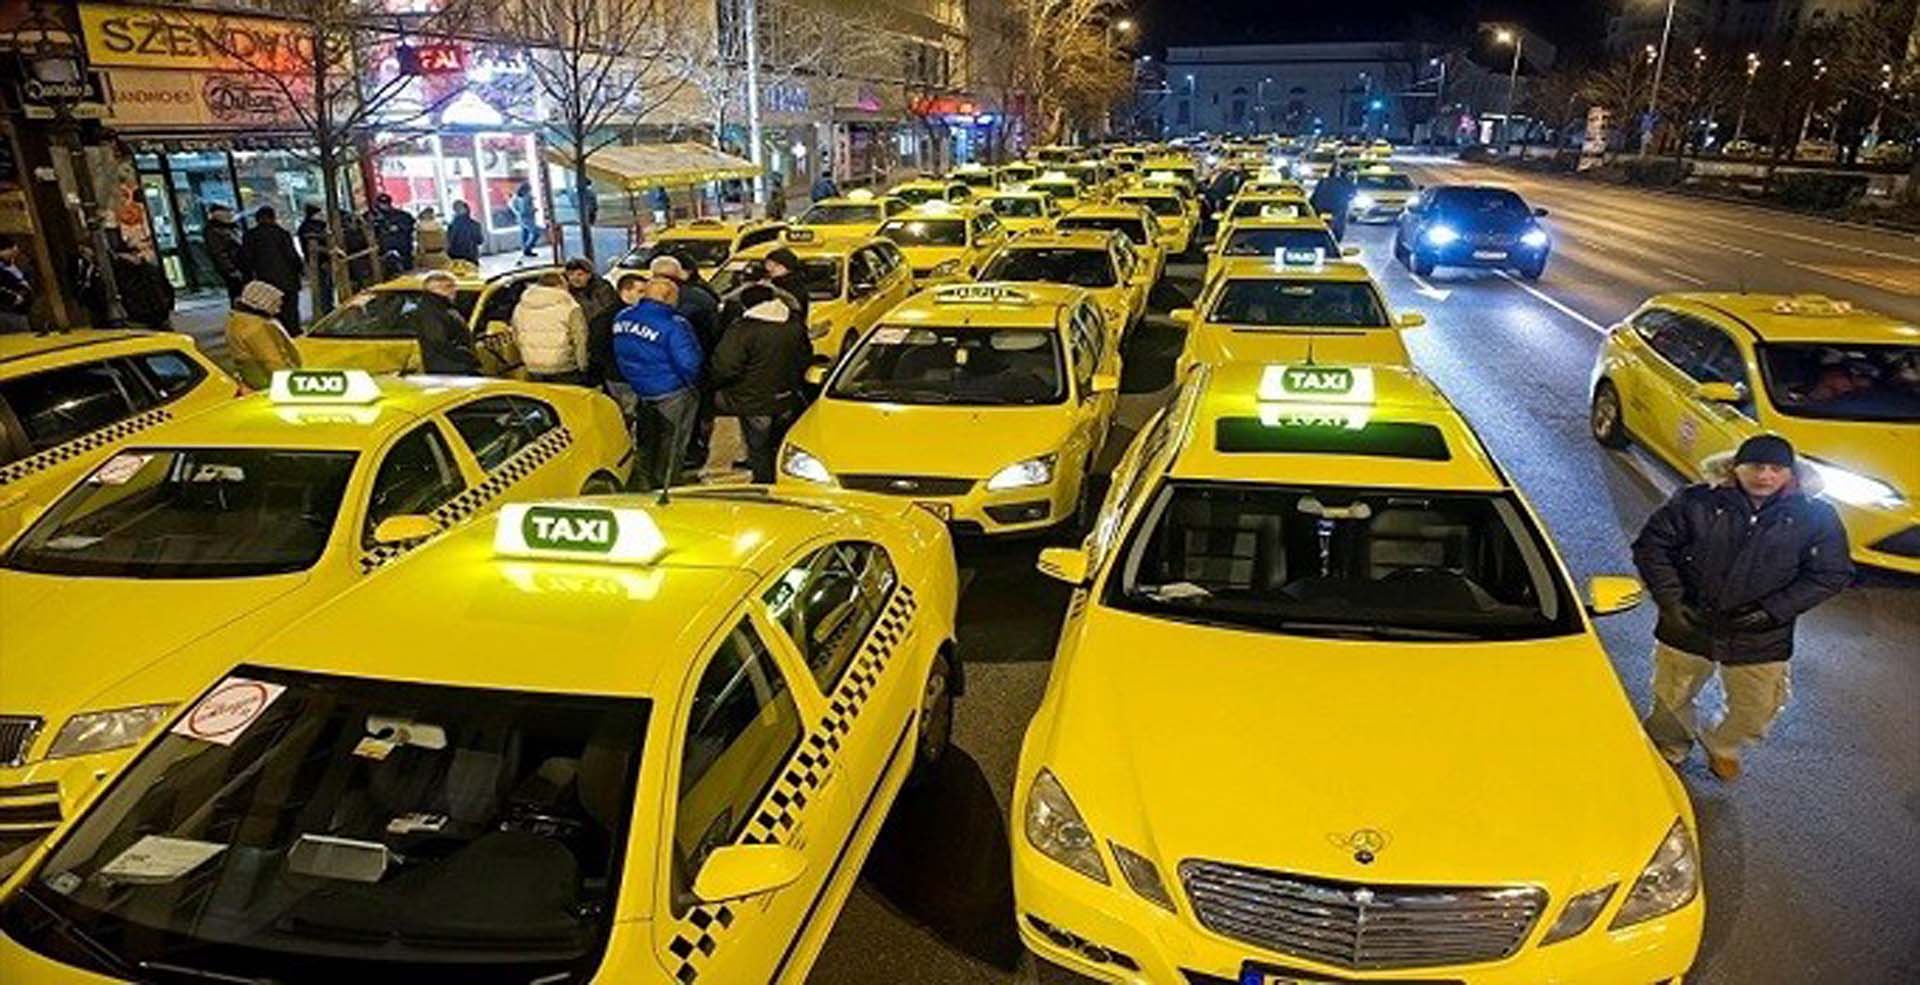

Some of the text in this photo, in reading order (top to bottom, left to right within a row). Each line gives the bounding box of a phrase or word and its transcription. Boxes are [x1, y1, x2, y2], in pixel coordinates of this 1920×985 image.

[1286, 252, 1315, 261] TAXI
[293, 376, 343, 392] TAXI
[1289, 372, 1347, 390] TAXI
[532, 515, 610, 544] TAXI
